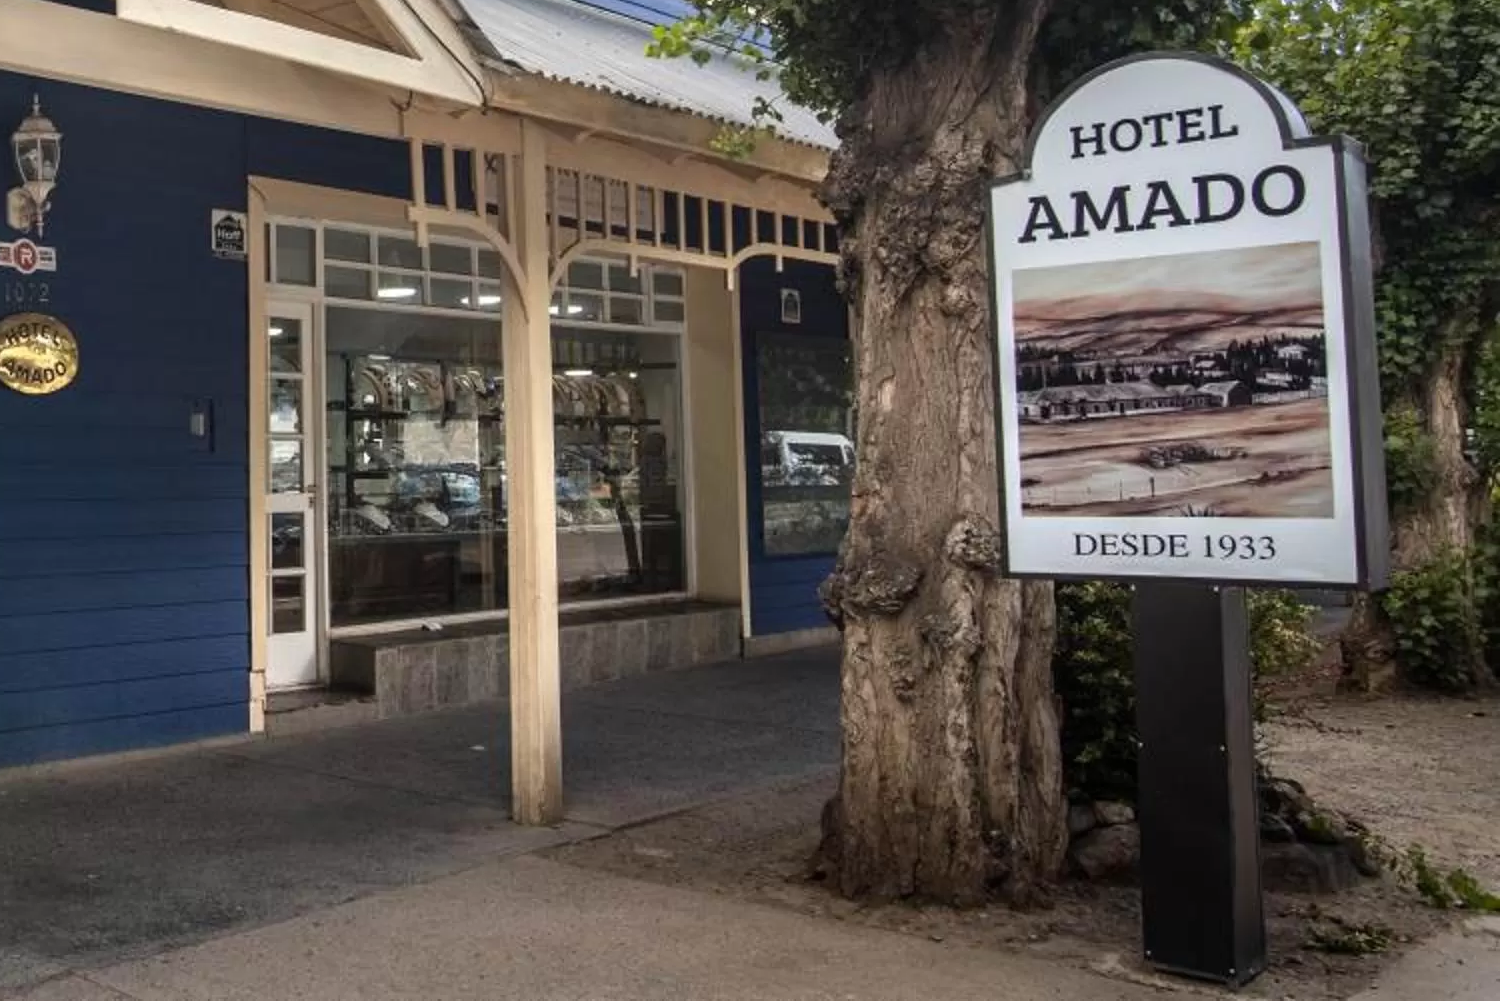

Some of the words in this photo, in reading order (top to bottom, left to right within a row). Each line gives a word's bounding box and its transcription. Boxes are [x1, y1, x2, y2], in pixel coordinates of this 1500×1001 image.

[1070, 104, 1239, 159] HOTEL
[1018, 164, 1307, 243] AMADO
[4, 322, 62, 346] HOTEL
[1, 358, 67, 384] AMADO
[1072, 532, 1190, 558] DESDE
[1202, 533, 1277, 560] 1933
